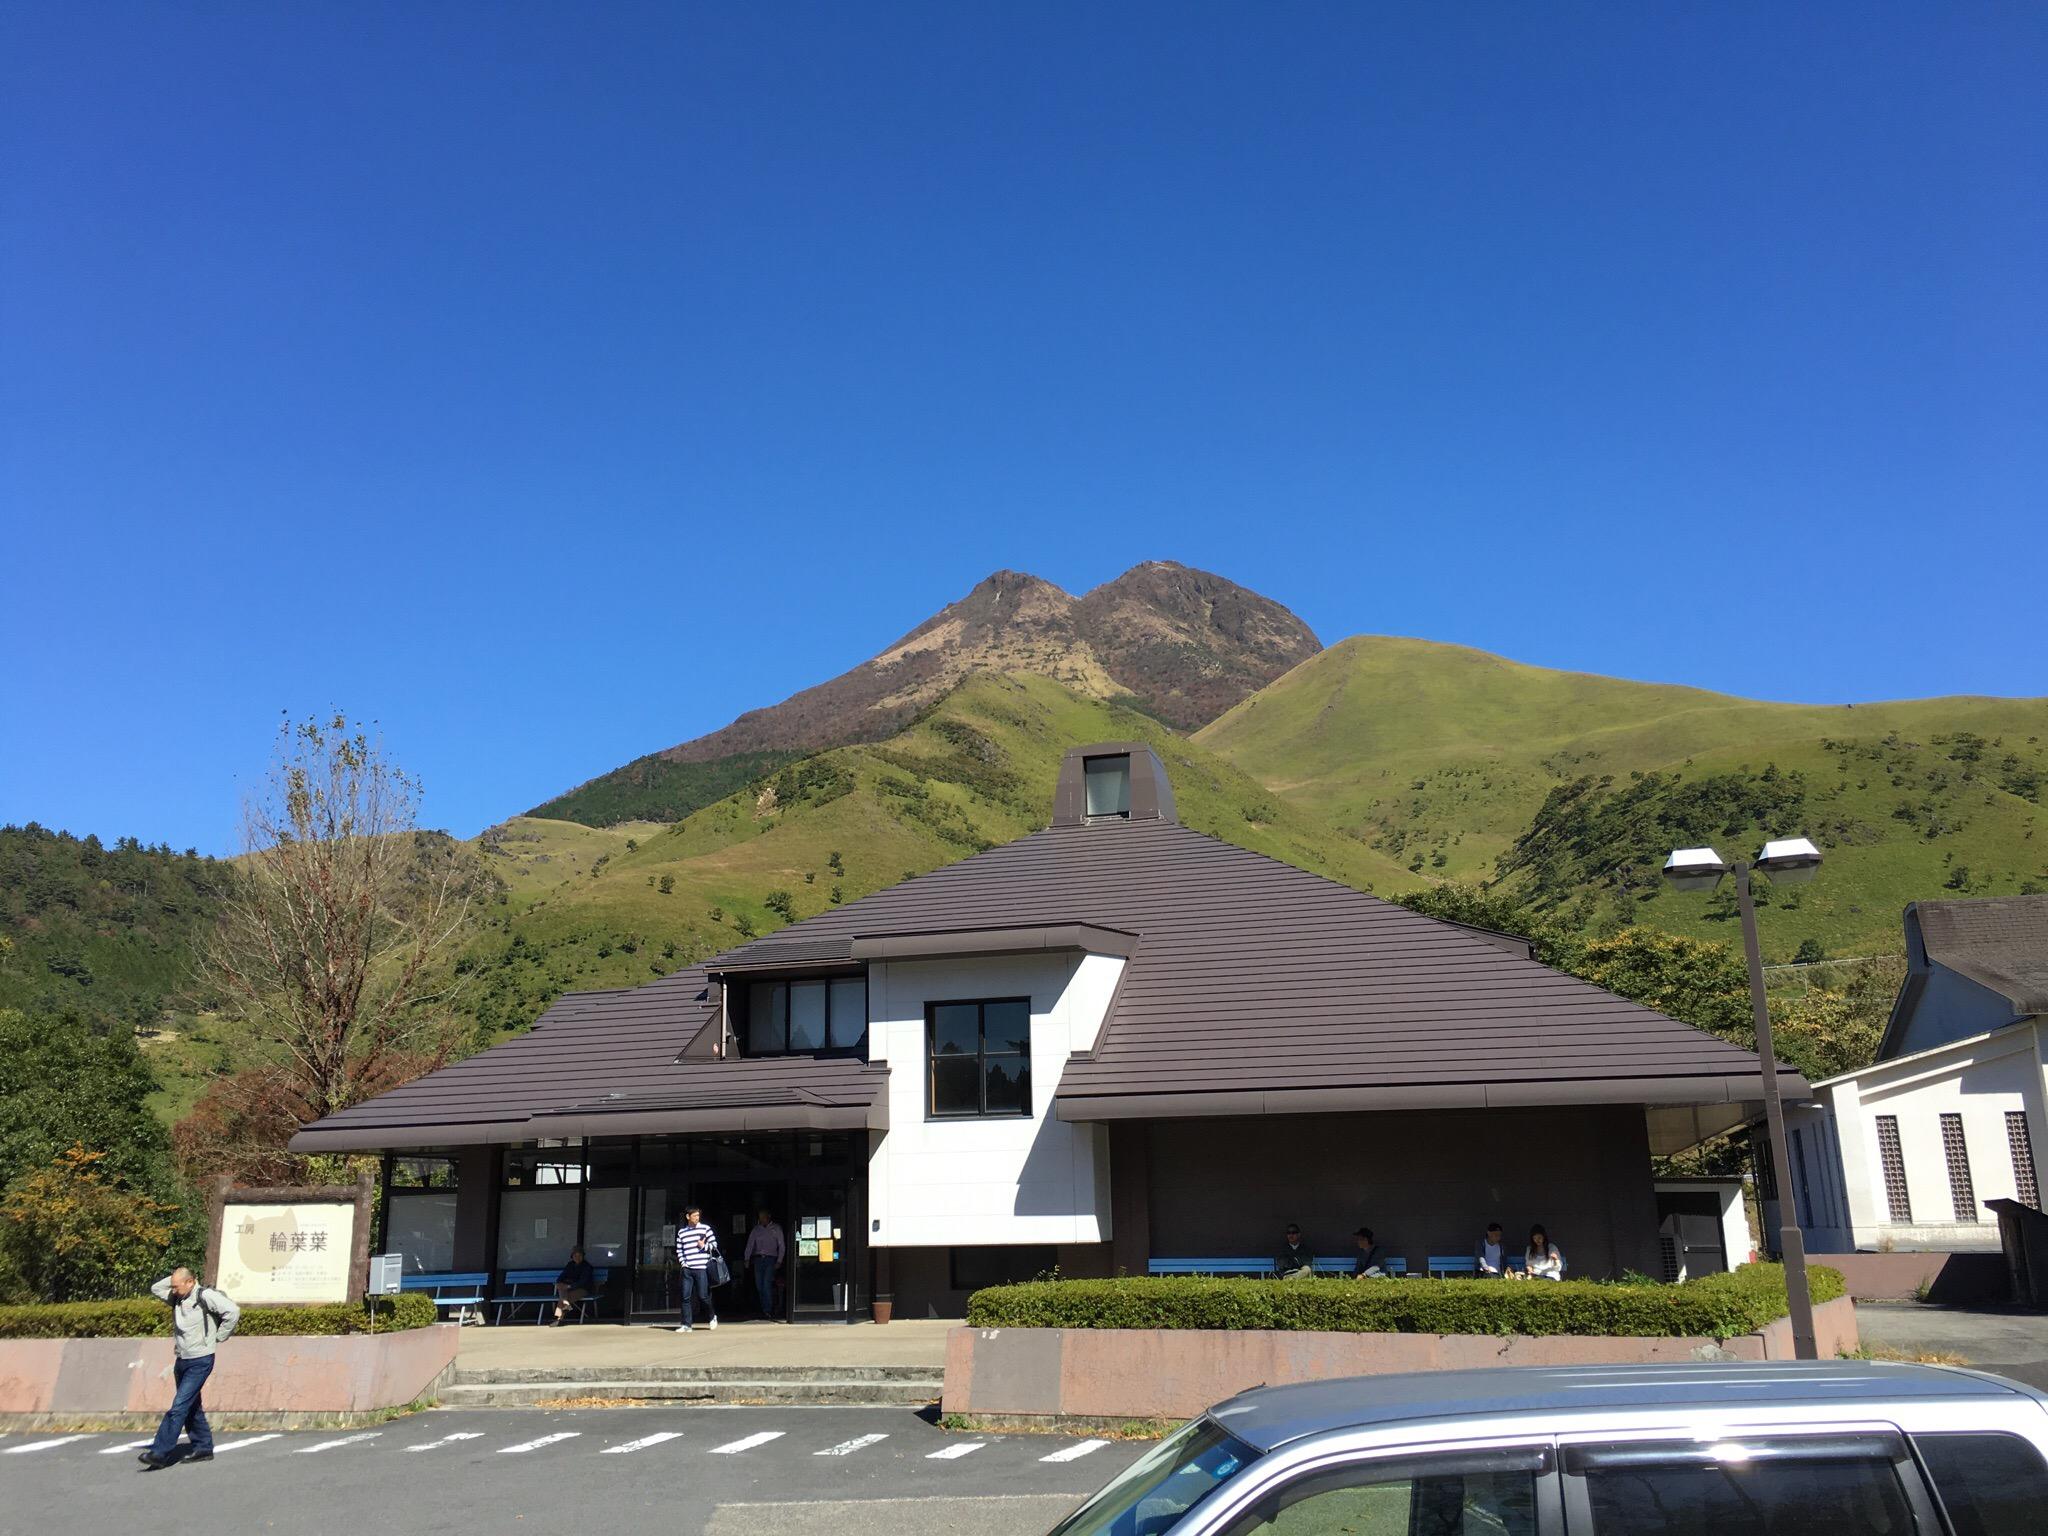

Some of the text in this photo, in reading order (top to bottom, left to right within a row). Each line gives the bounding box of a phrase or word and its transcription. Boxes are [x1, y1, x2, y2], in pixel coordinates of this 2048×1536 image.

[234, 1223, 255, 1235] 工房
[268, 1231, 328, 1253] 輪葉葉
